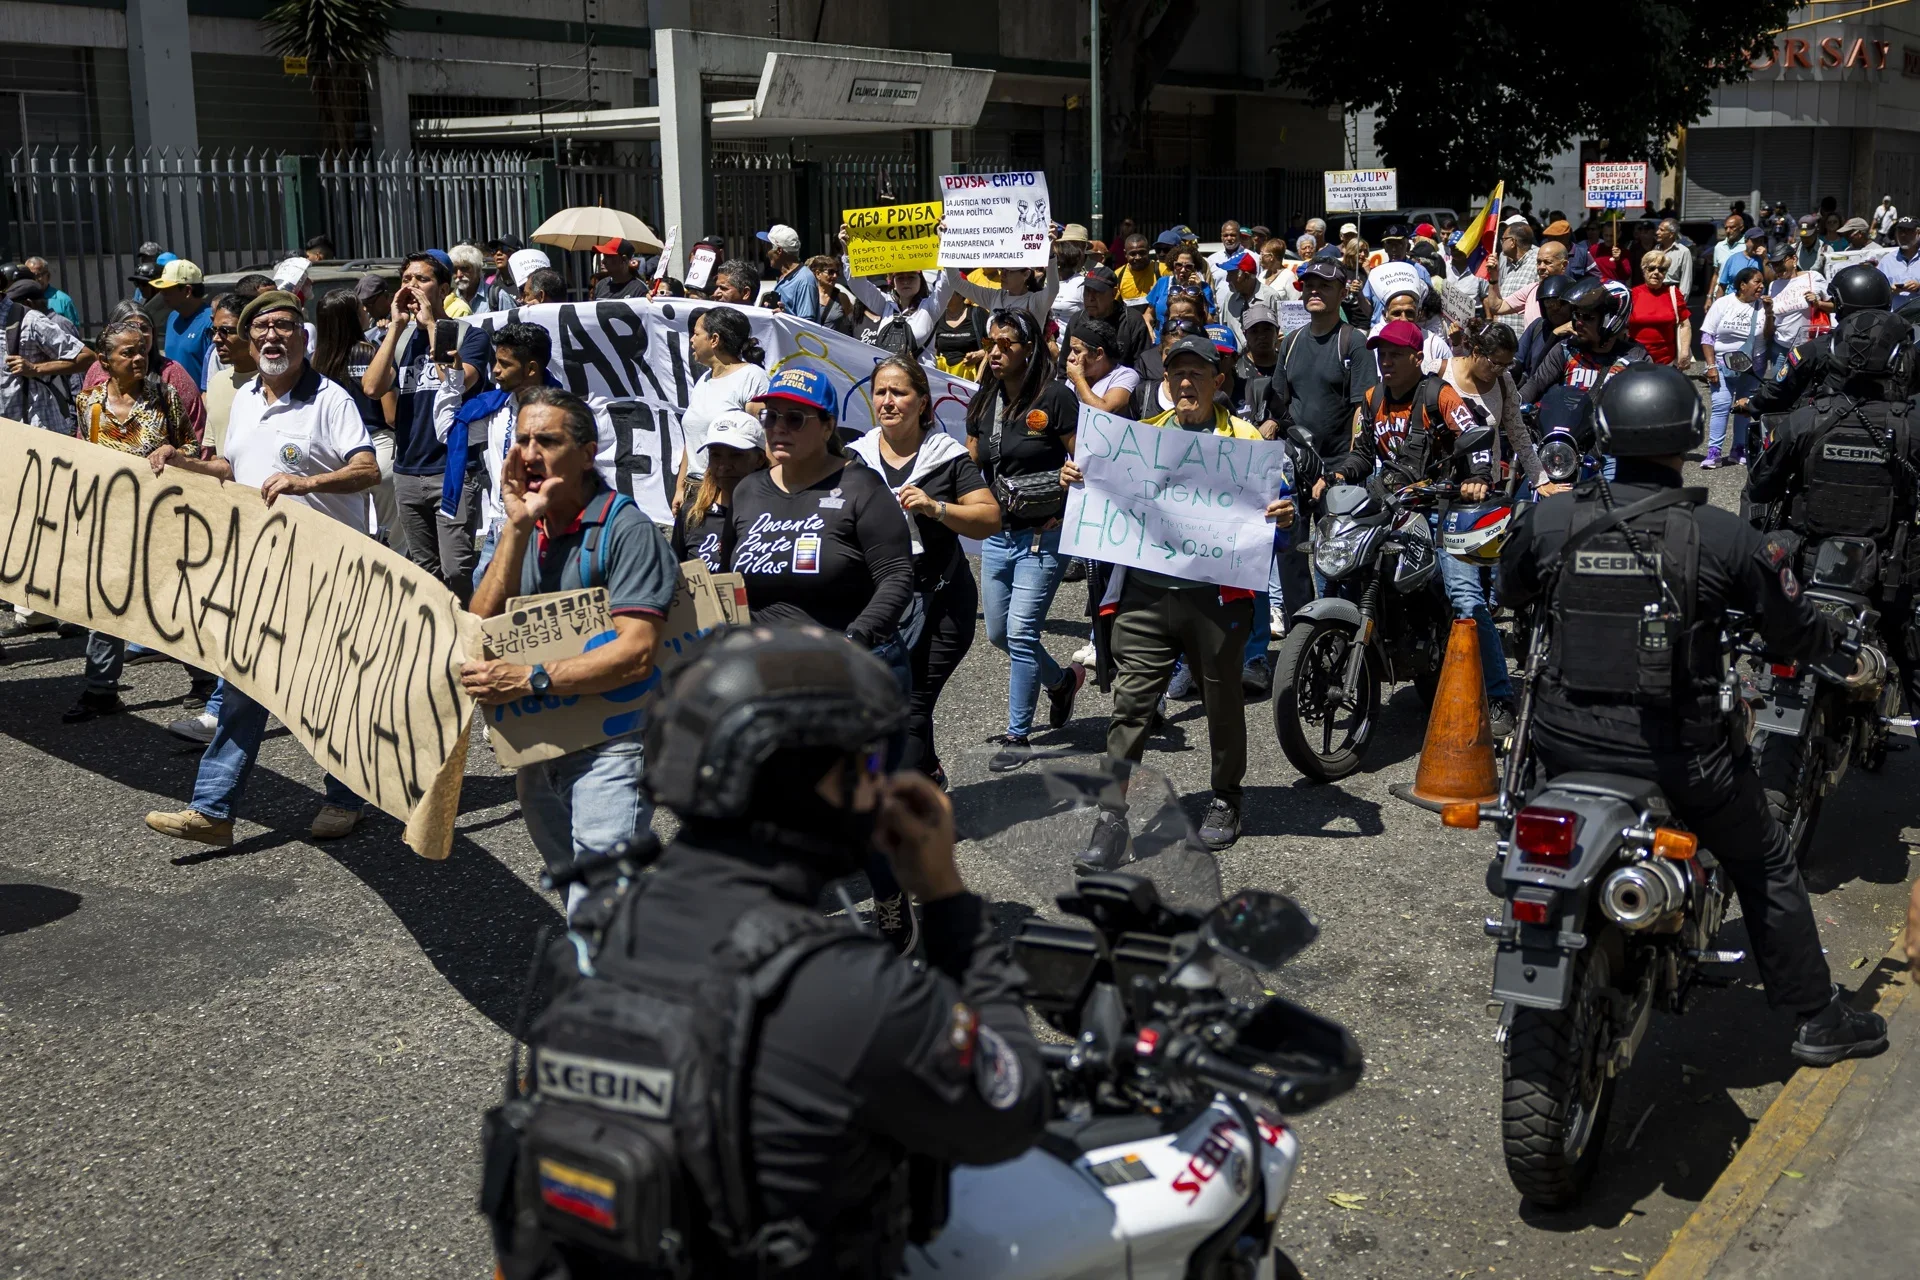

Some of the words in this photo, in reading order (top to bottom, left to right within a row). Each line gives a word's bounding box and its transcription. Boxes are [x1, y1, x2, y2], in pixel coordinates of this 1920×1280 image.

[893, 89, 918, 99] RAZETTI
[992, 172, 1034, 188] CRIPTO
[1333, 172, 1389, 184] FENAJUPV
[1354, 199, 1368, 208] YA
[887, 206, 936, 224] PDVSA
[966, 208, 993, 216] POLÍTICA
[943, 240, 994, 248] TRANSPARENCIA
[940, 252, 980, 260] TRIBUNALES
[1826, 447, 1884, 460] SEBIN
[748, 512, 825, 535] Docente
[1075, 493, 1146, 560] HOY
[736, 534, 793, 554] Ponte
[733, 552, 788, 574] Pilas
[0, 448, 297, 694] DEMOCRACIA
[285, 562, 328, 714] Y
[512, 588, 606, 626] PUEBLO
[1516, 865, 1566, 880] SUZUKI
[542, 1061, 667, 1109] SEBIN
